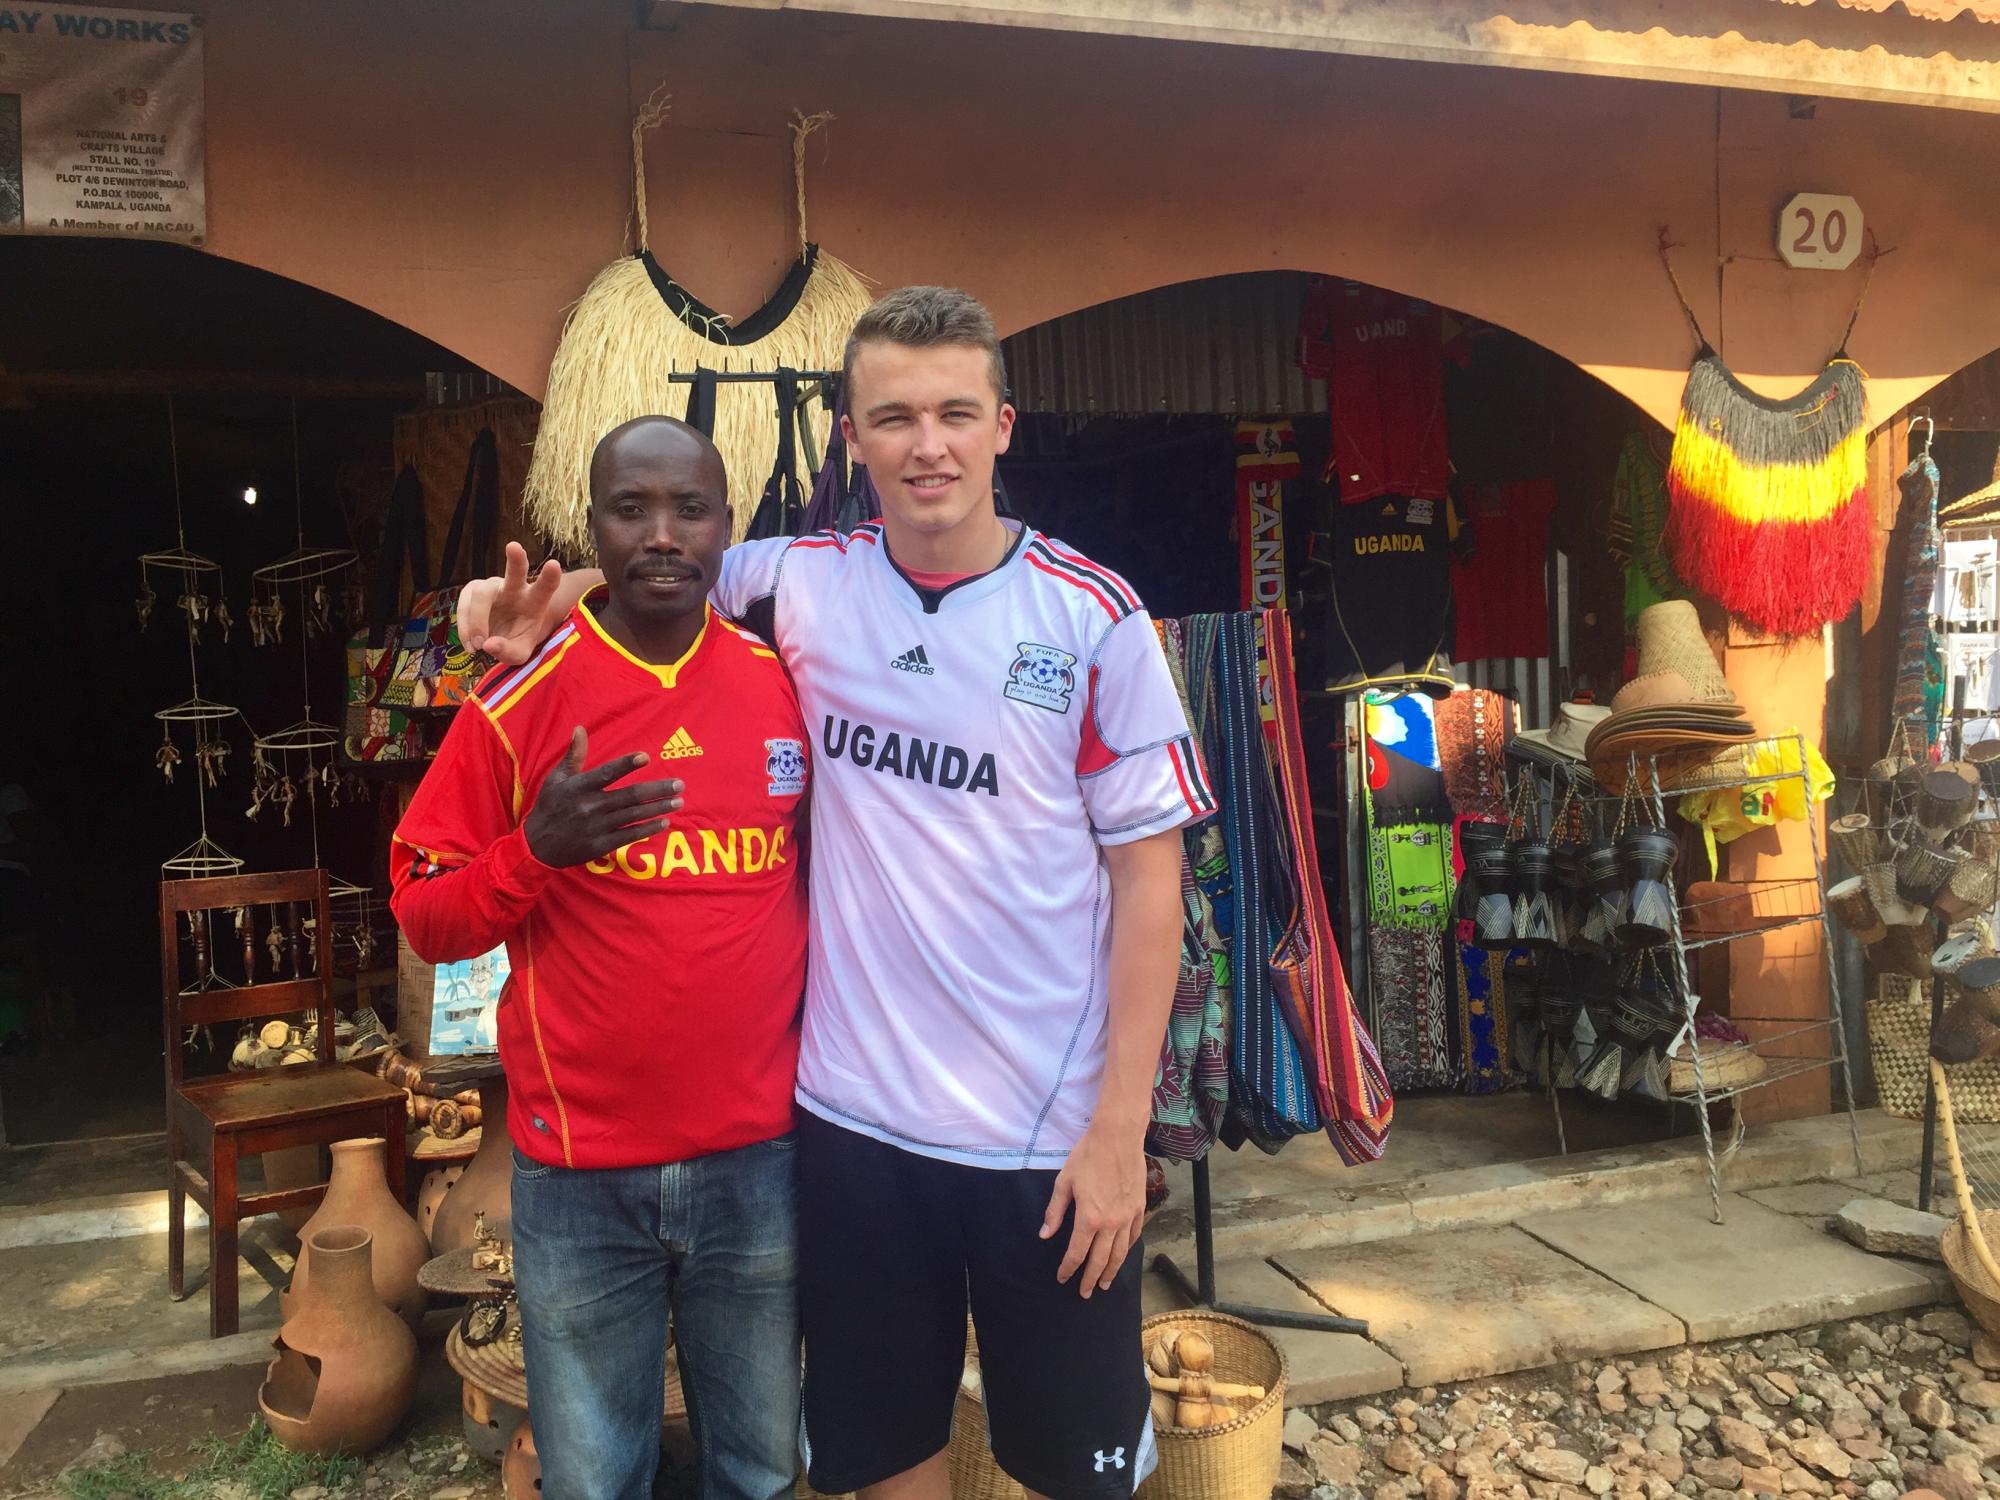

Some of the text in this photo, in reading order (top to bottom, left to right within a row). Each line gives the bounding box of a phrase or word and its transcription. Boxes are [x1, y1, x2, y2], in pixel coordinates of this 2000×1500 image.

[54, 14, 190, 44] WORKS
[76, 129, 127, 141] NATIONAL
[130, 131, 156, 143] ARTS
[80, 142, 165, 155] CRAFTS VILLAGE
[89, 155, 156, 167] STALL NO. 19
[105, 167, 139, 175] NATIONAL
[56, 173, 82, 184] PLOT
[85, 175, 100, 185] 4/6
[158, 178, 189, 191] ROAD,
[76, 199, 171, 213] KAMPALA, UGANDA
[49, 218, 194, 233] A Member of NACAU
[1793, 208, 1846, 254] 20
[1354, 533, 1425, 556] UGANDA
[1036, 649, 1060, 658] FUFA
[890, 658, 935, 676] adidas
[1023, 681, 1057, 694] UGANDA
[660, 744, 704, 760] adidas
[823, 714, 999, 796] UGANDA
